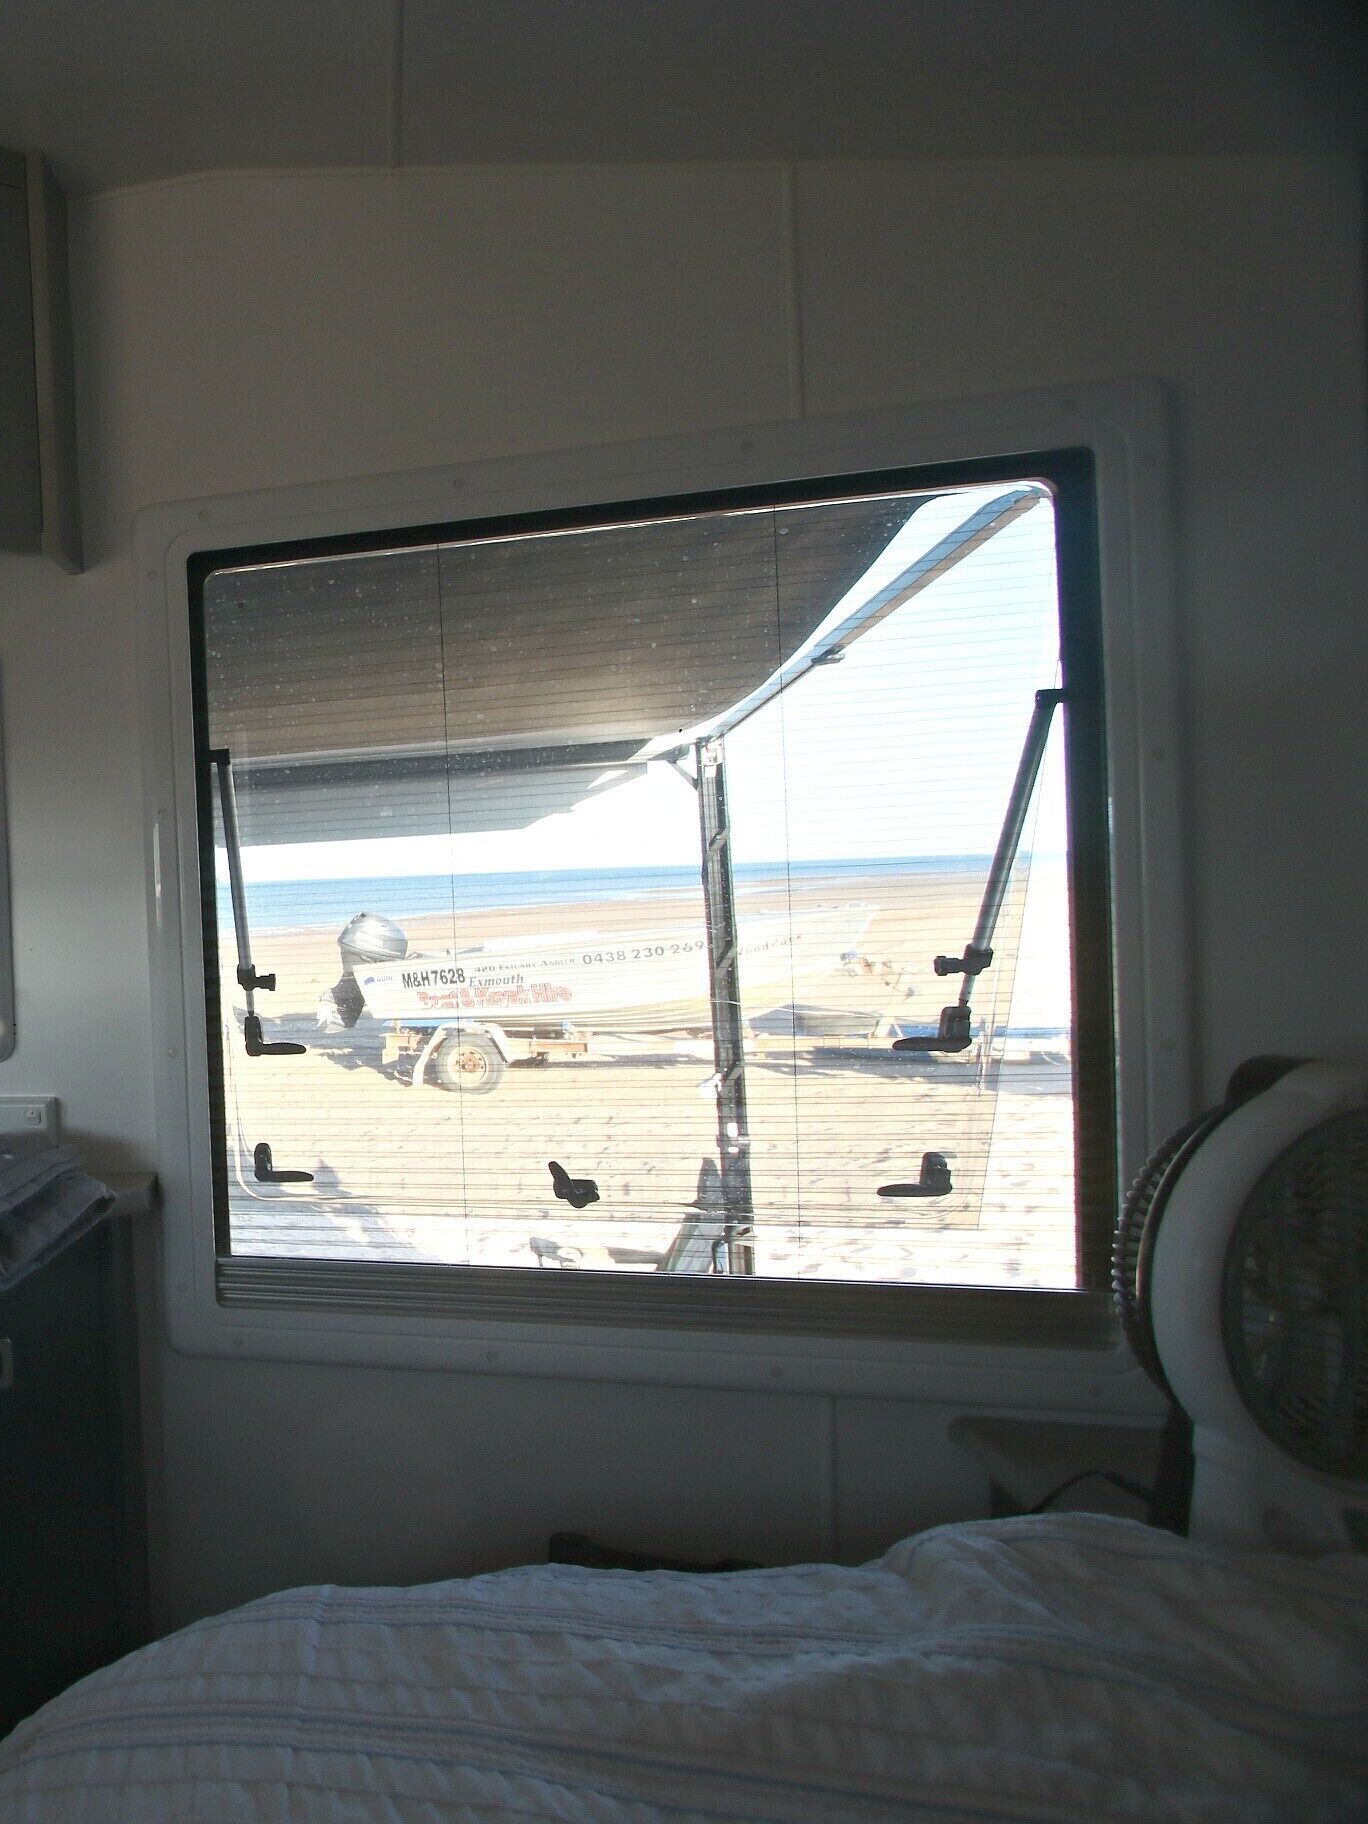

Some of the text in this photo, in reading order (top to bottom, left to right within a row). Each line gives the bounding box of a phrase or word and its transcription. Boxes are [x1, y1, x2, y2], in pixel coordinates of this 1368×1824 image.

[582, 940, 706, 966] 0438 230 269
[401, 967, 466, 989] M&H7628
[468, 973, 525, 989] Exmouth
[531, 983, 573, 1004] Hire
